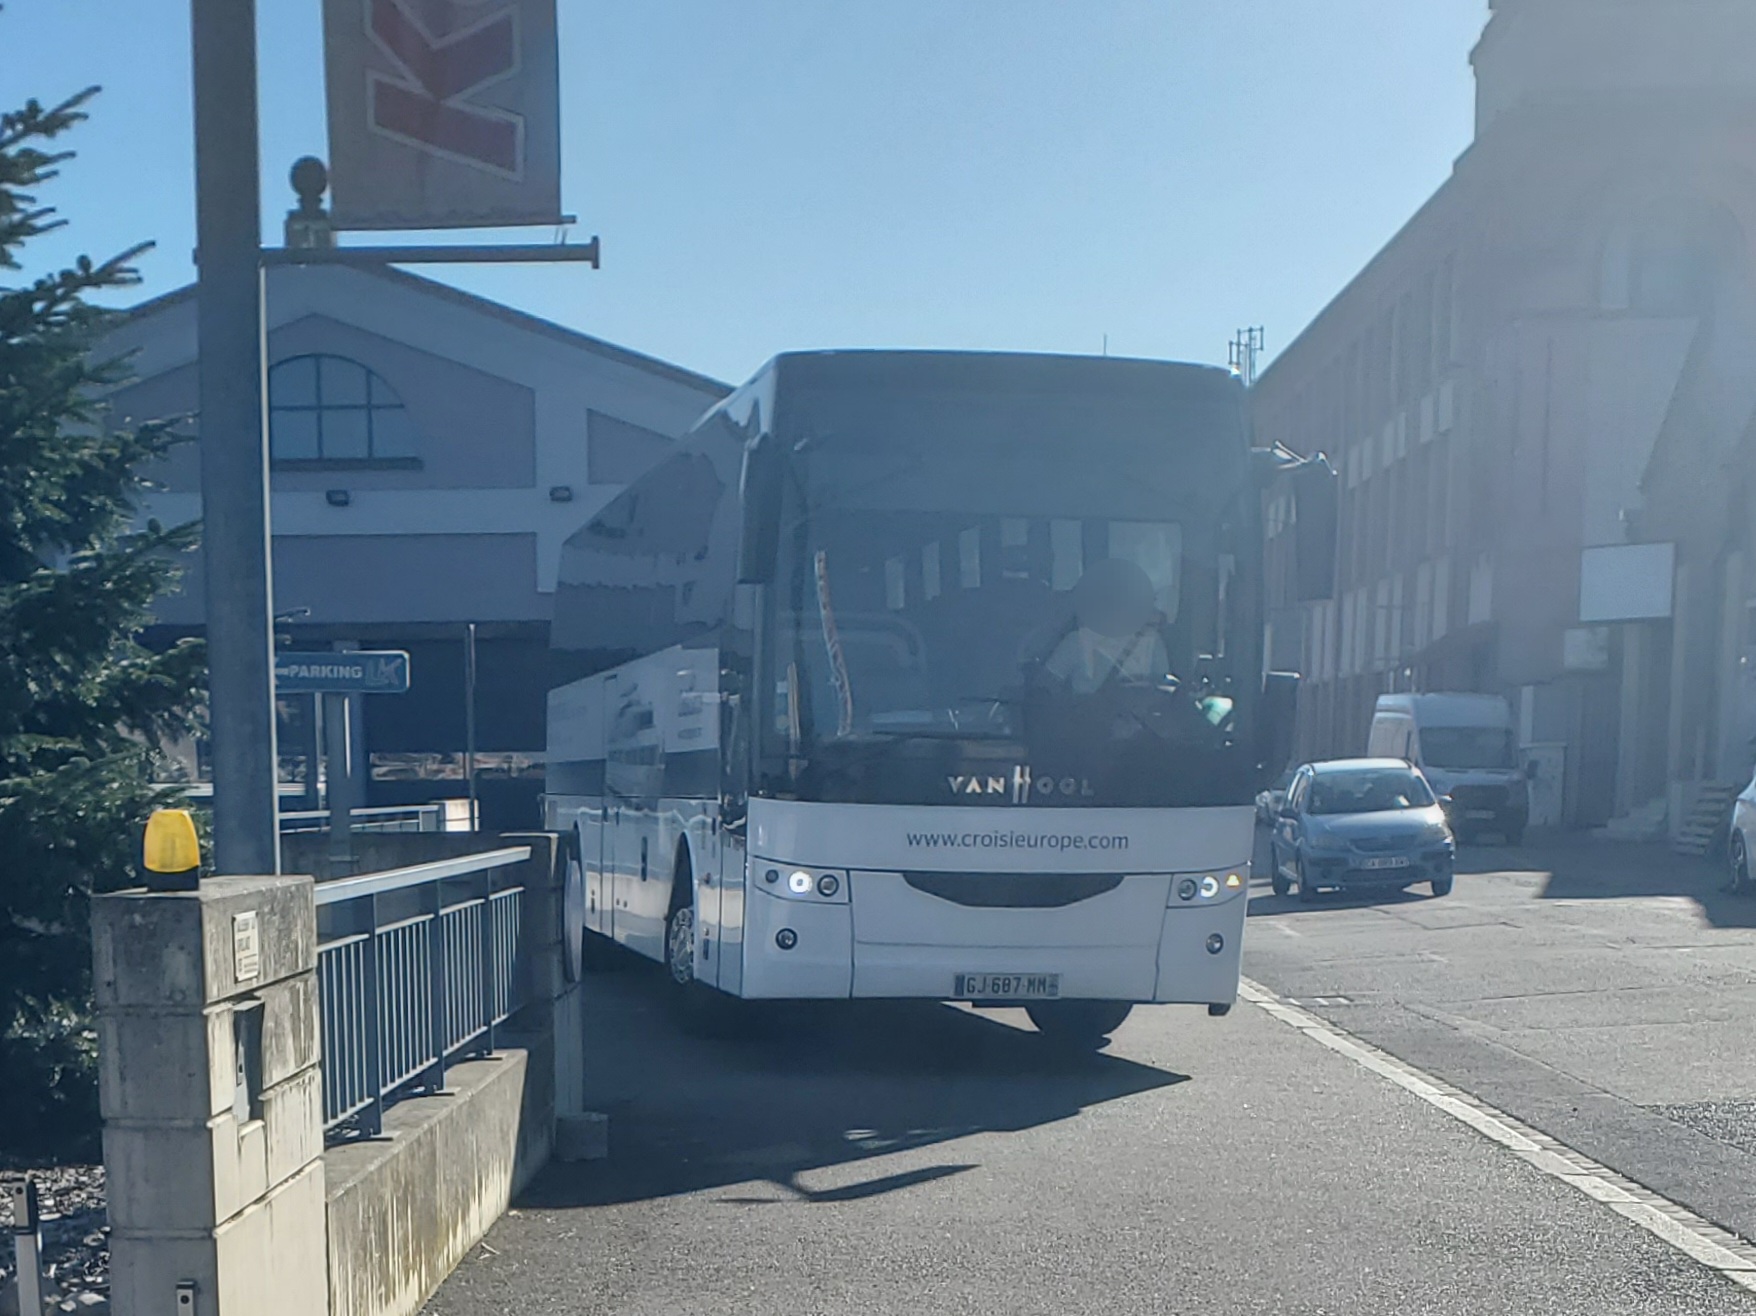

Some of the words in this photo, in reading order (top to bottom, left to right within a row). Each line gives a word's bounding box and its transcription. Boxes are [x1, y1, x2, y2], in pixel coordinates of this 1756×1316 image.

[288, 664, 363, 679] PARKING
[946, 775, 1006, 795] VAN
[1012, 764, 1096, 805] HOOL
[906, 830, 1130, 852] www.croisieurope.com
